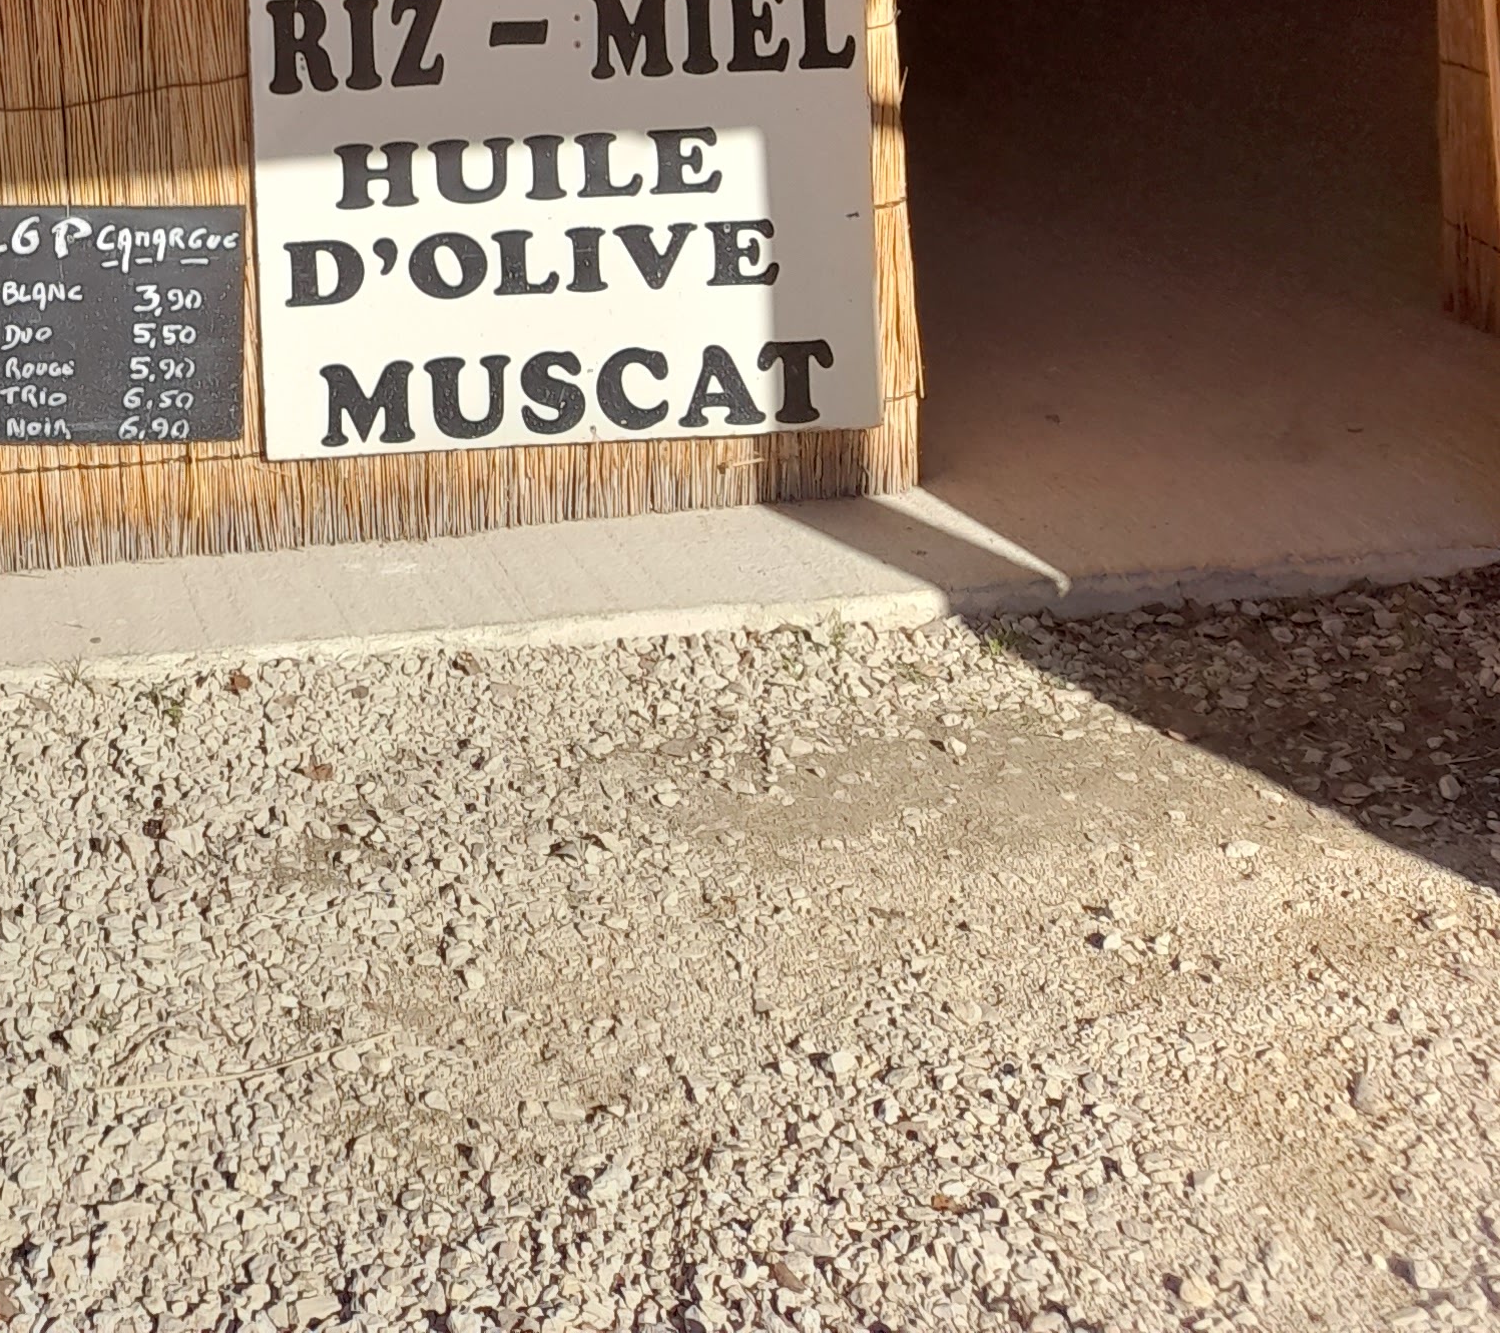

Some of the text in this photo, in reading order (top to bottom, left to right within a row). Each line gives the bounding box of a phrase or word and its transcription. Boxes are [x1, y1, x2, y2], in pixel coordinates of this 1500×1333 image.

[334, 127, 722, 209] HUILE
[283, 219, 779, 307] D'OLIVE
[133, 284, 202, 317] 3,90
[133, 322, 197, 349] 5,50
[130, 355, 196, 382] 5,90
[123, 386, 194, 410] 6,50
[319, 340, 833, 447] MUSCAT
[118, 415, 190, 440] 6,90
